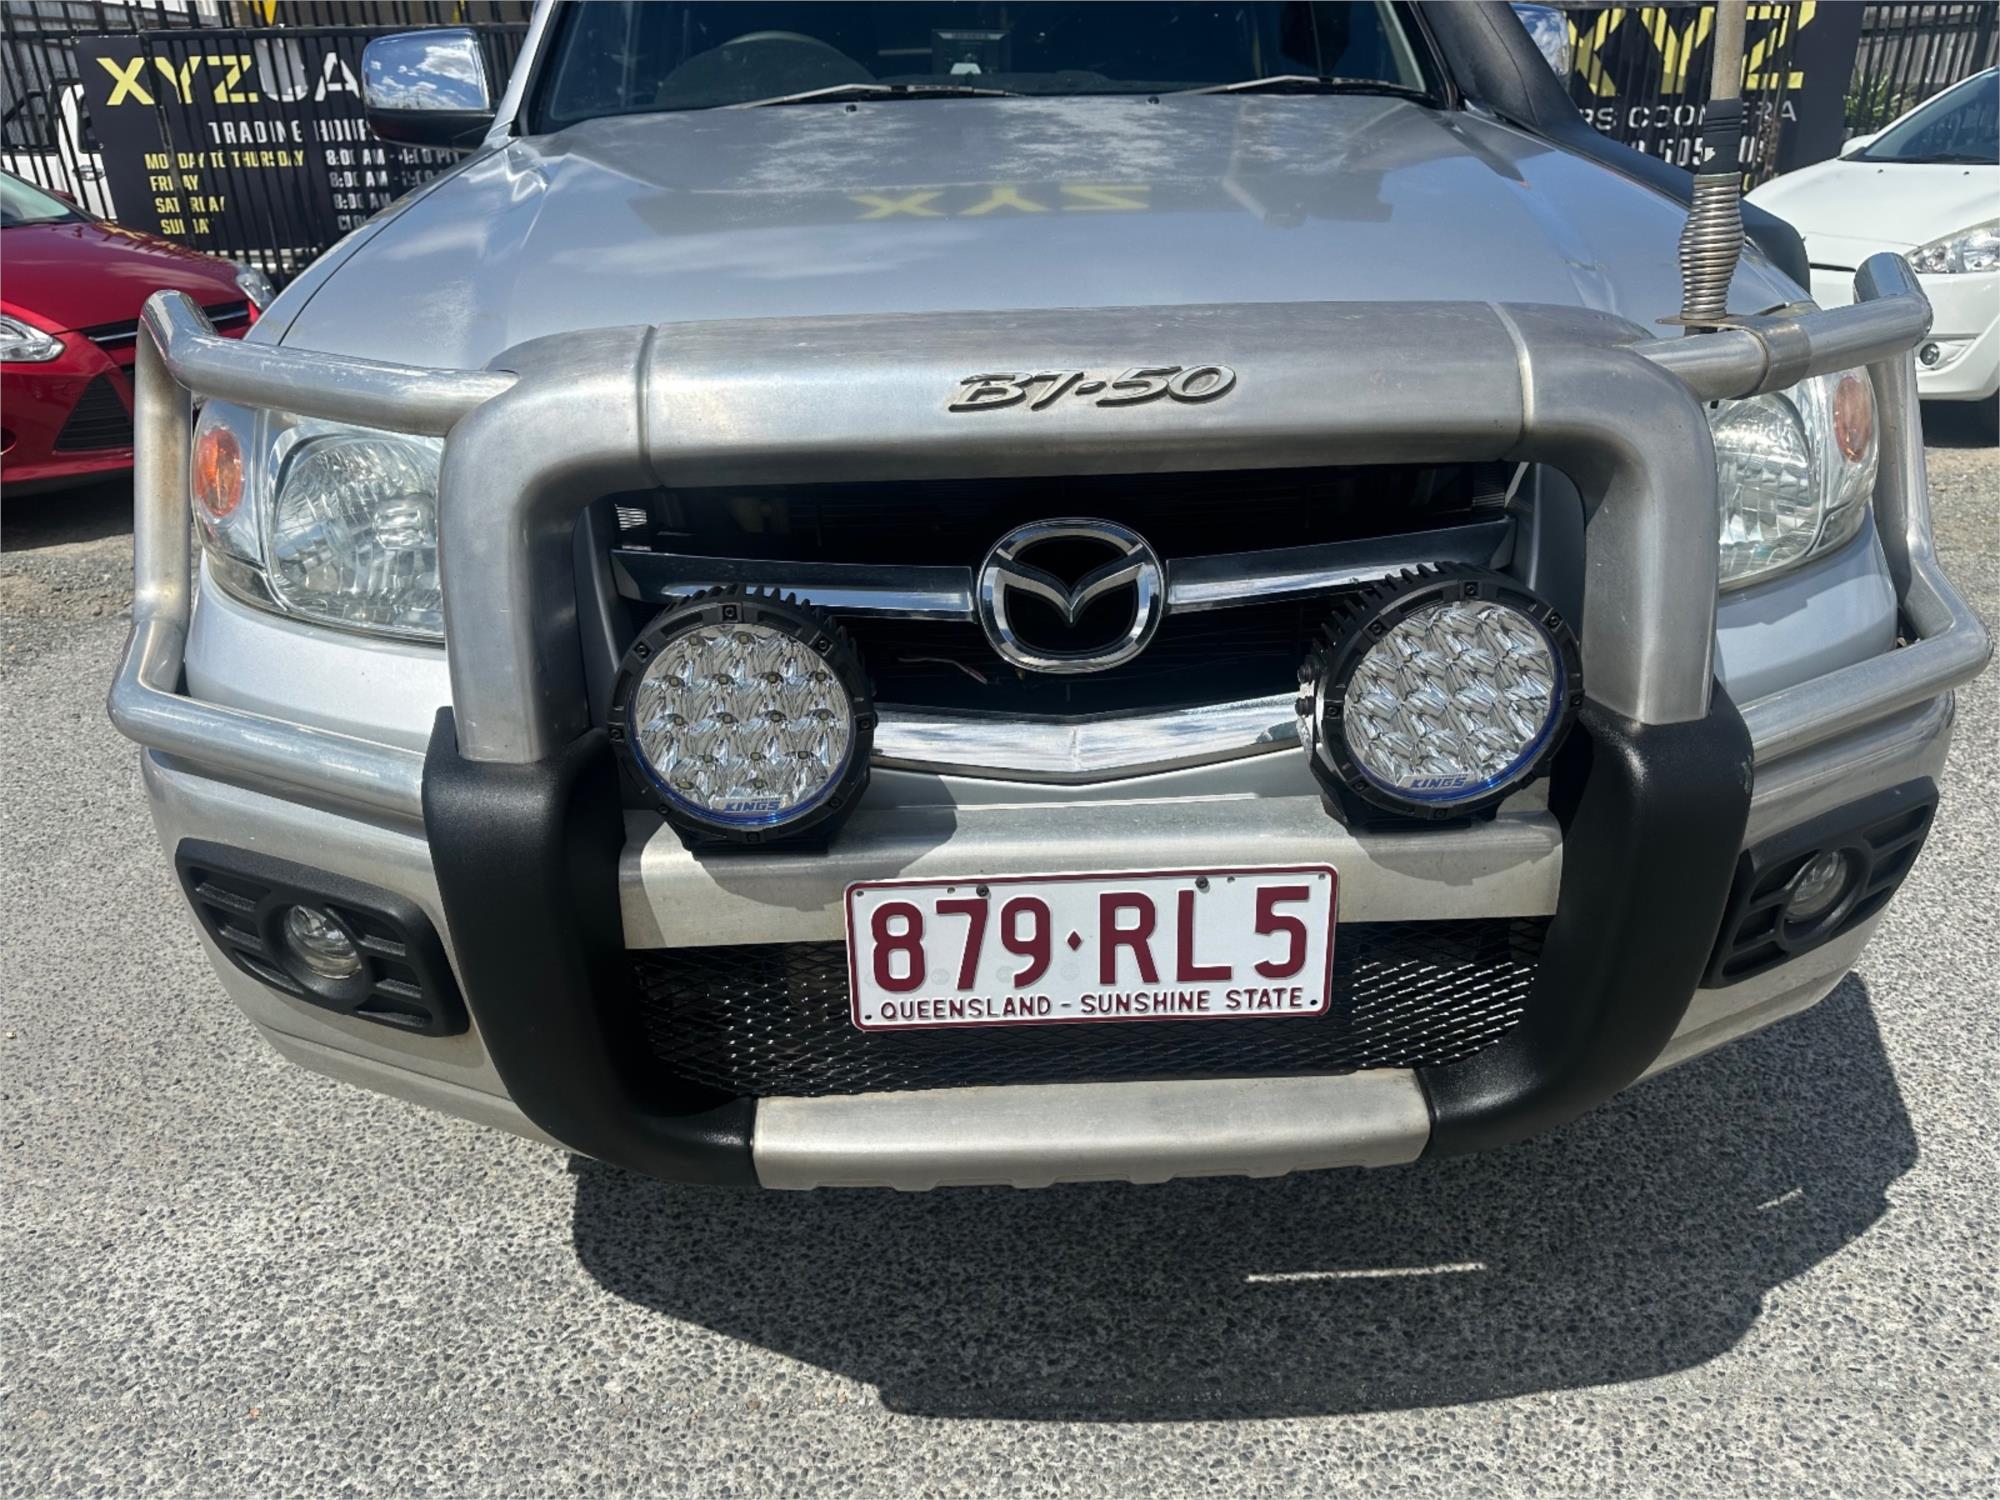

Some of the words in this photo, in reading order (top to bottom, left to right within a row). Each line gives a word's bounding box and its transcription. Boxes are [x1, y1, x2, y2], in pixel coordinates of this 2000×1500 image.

[96, 55, 259, 106] XYZ
[1628, 100, 1798, 129] COORA
[313, 118, 381, 142] HOUR
[144, 152, 204, 170] MODAY
[150, 174, 199, 192] FRIAY
[155, 196, 225, 214] SATRA
[948, 364, 1237, 412] BT-50
[1411, 777, 1467, 788] KINGS
[724, 801, 781, 812] KINGS
[880, 995, 1051, 1020] QUEENSLAND
[1081, 989, 1210, 1013] SUNSHINE
[1225, 986, 1303, 1009] STATE
